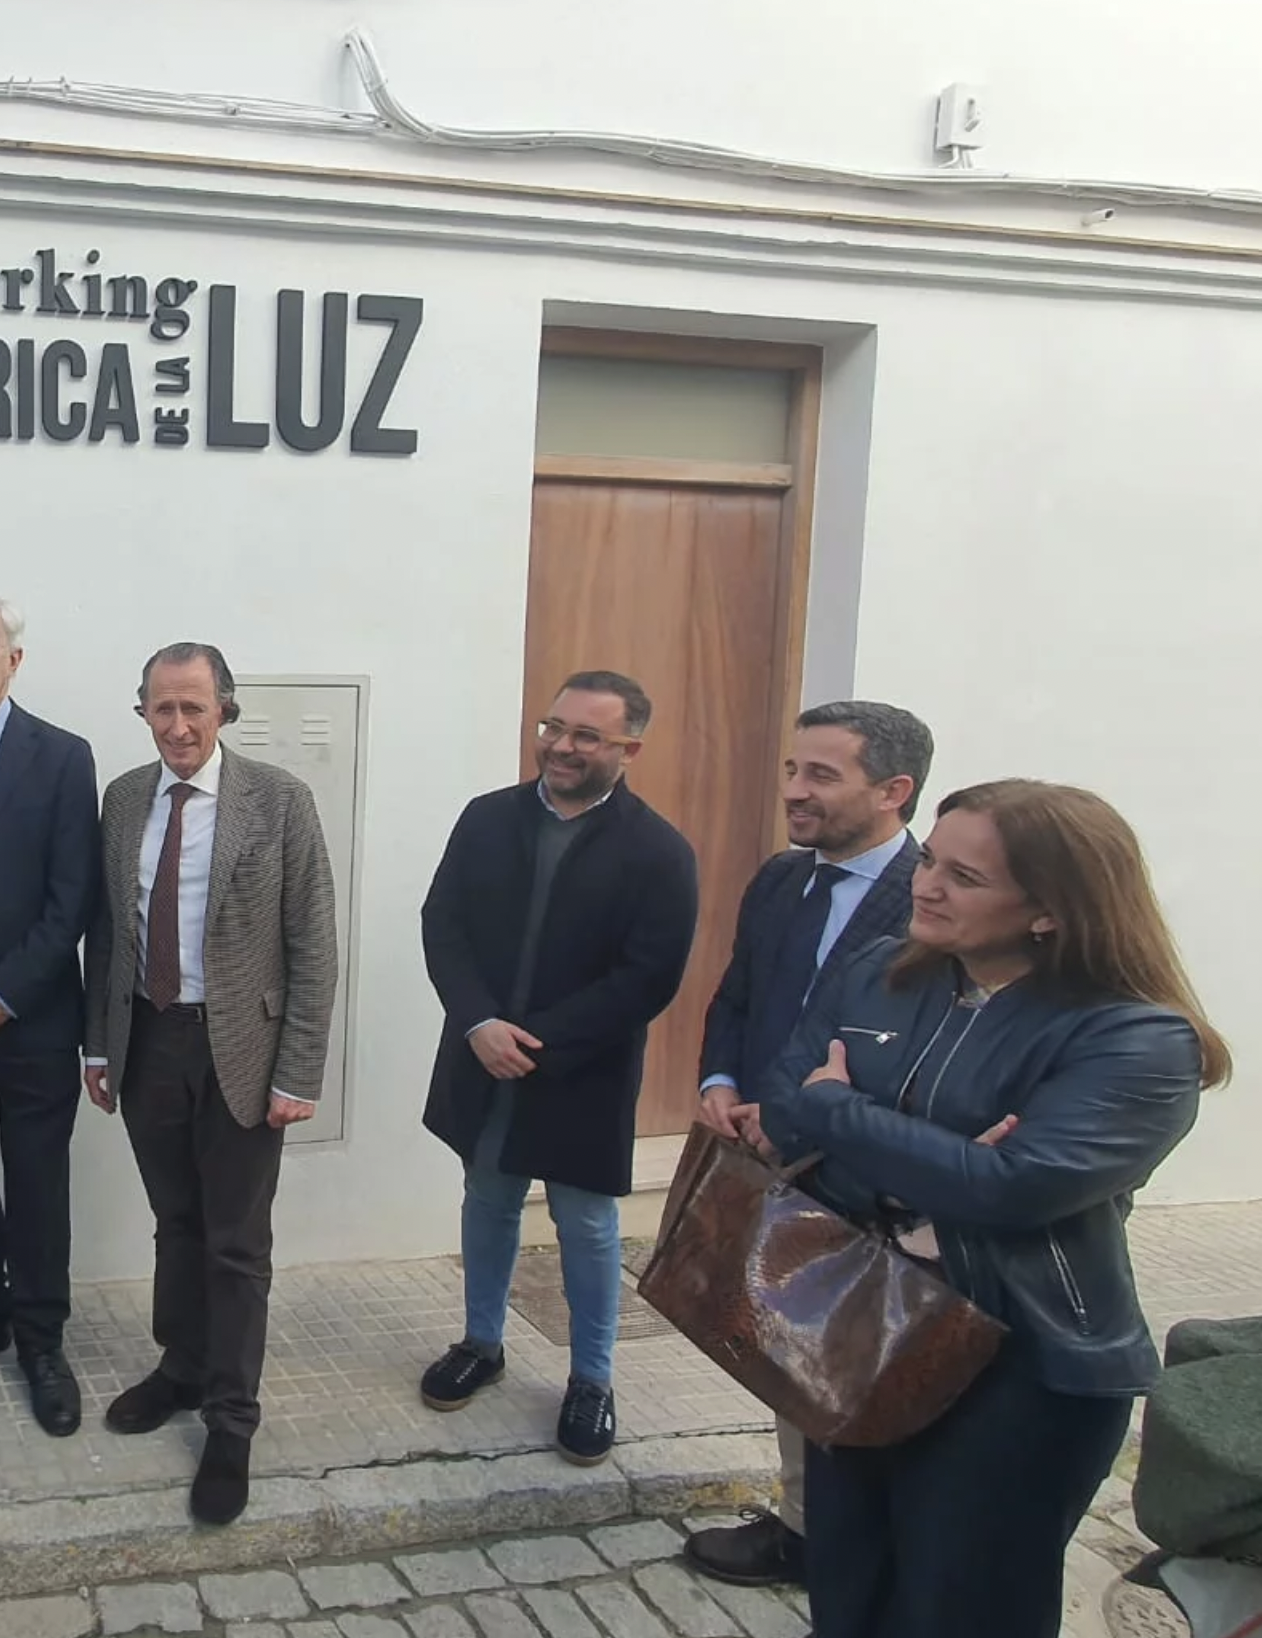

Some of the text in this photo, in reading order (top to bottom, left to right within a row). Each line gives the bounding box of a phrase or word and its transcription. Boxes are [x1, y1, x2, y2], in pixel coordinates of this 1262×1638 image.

[154, 356, 190, 395] LA
[205, 284, 424, 458] LUZ
[154, 406, 190, 447] DE
